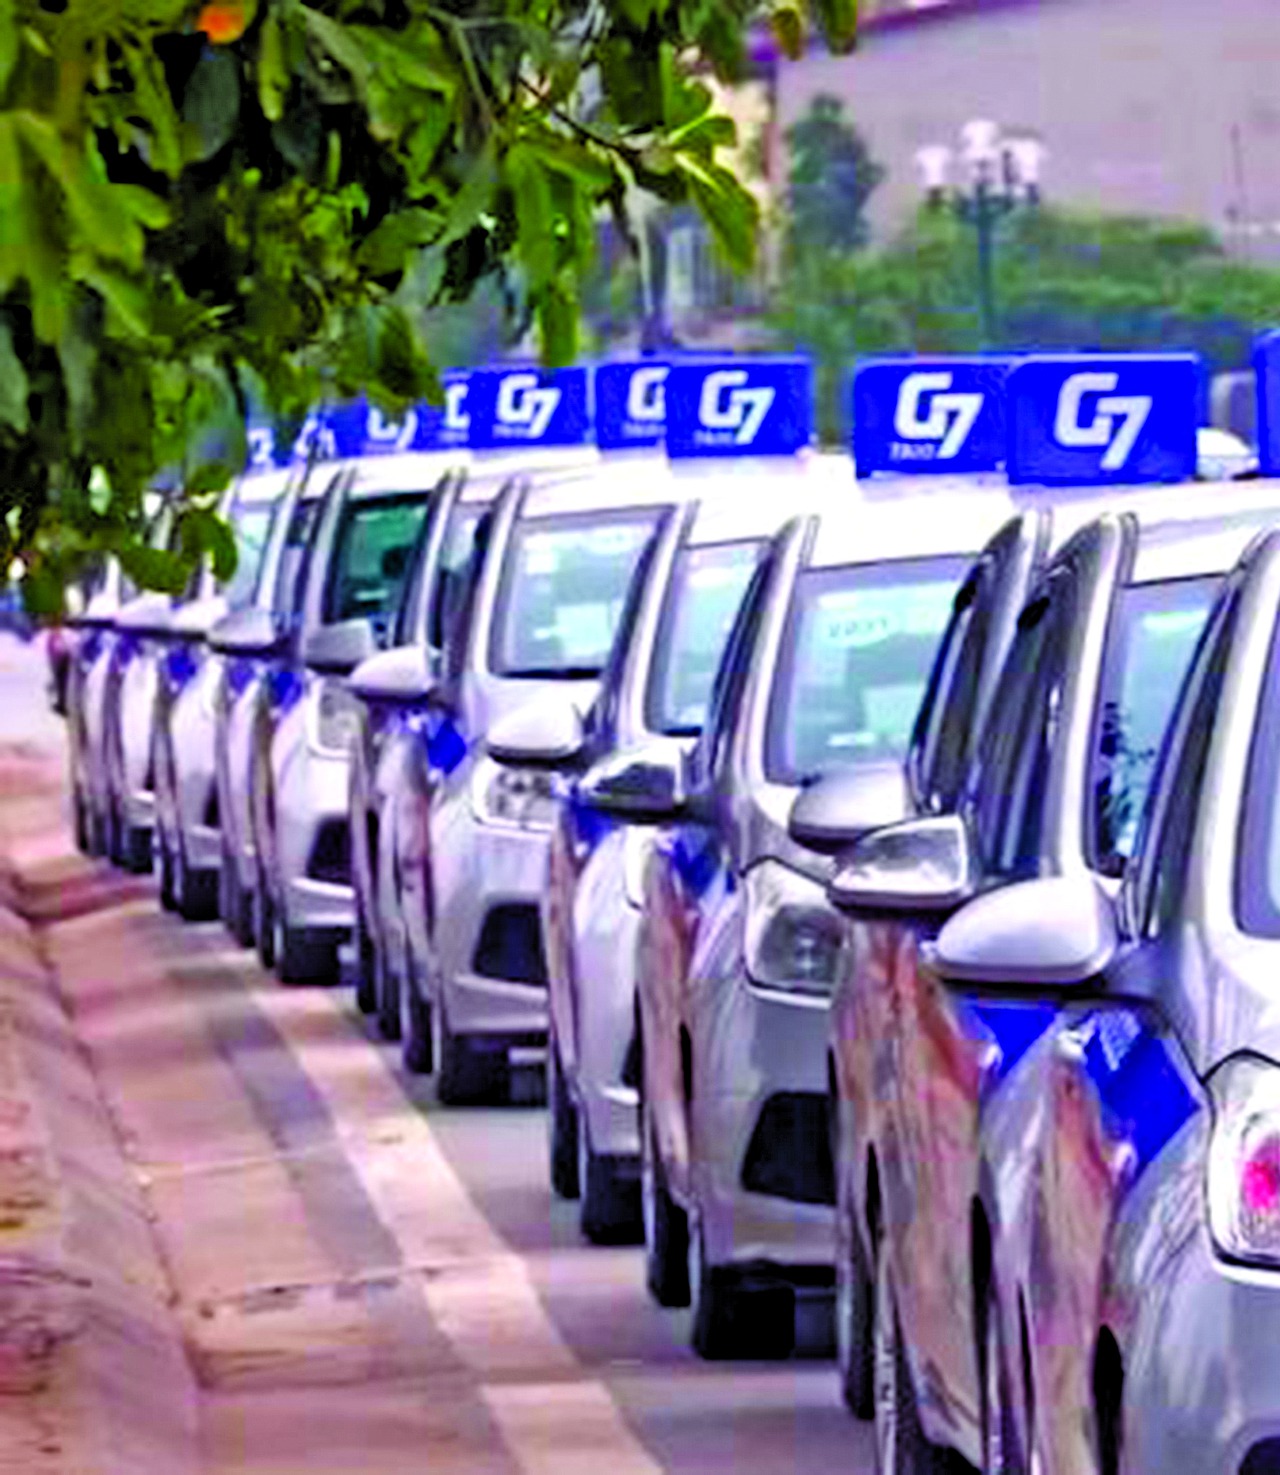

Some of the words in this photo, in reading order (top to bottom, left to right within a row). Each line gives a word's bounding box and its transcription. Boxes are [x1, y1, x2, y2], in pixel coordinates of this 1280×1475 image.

[495, 373, 562, 439] G7
[698, 369, 776, 445] G7
[893, 372, 984, 460] G7
[1054, 372, 1152, 470] G7
